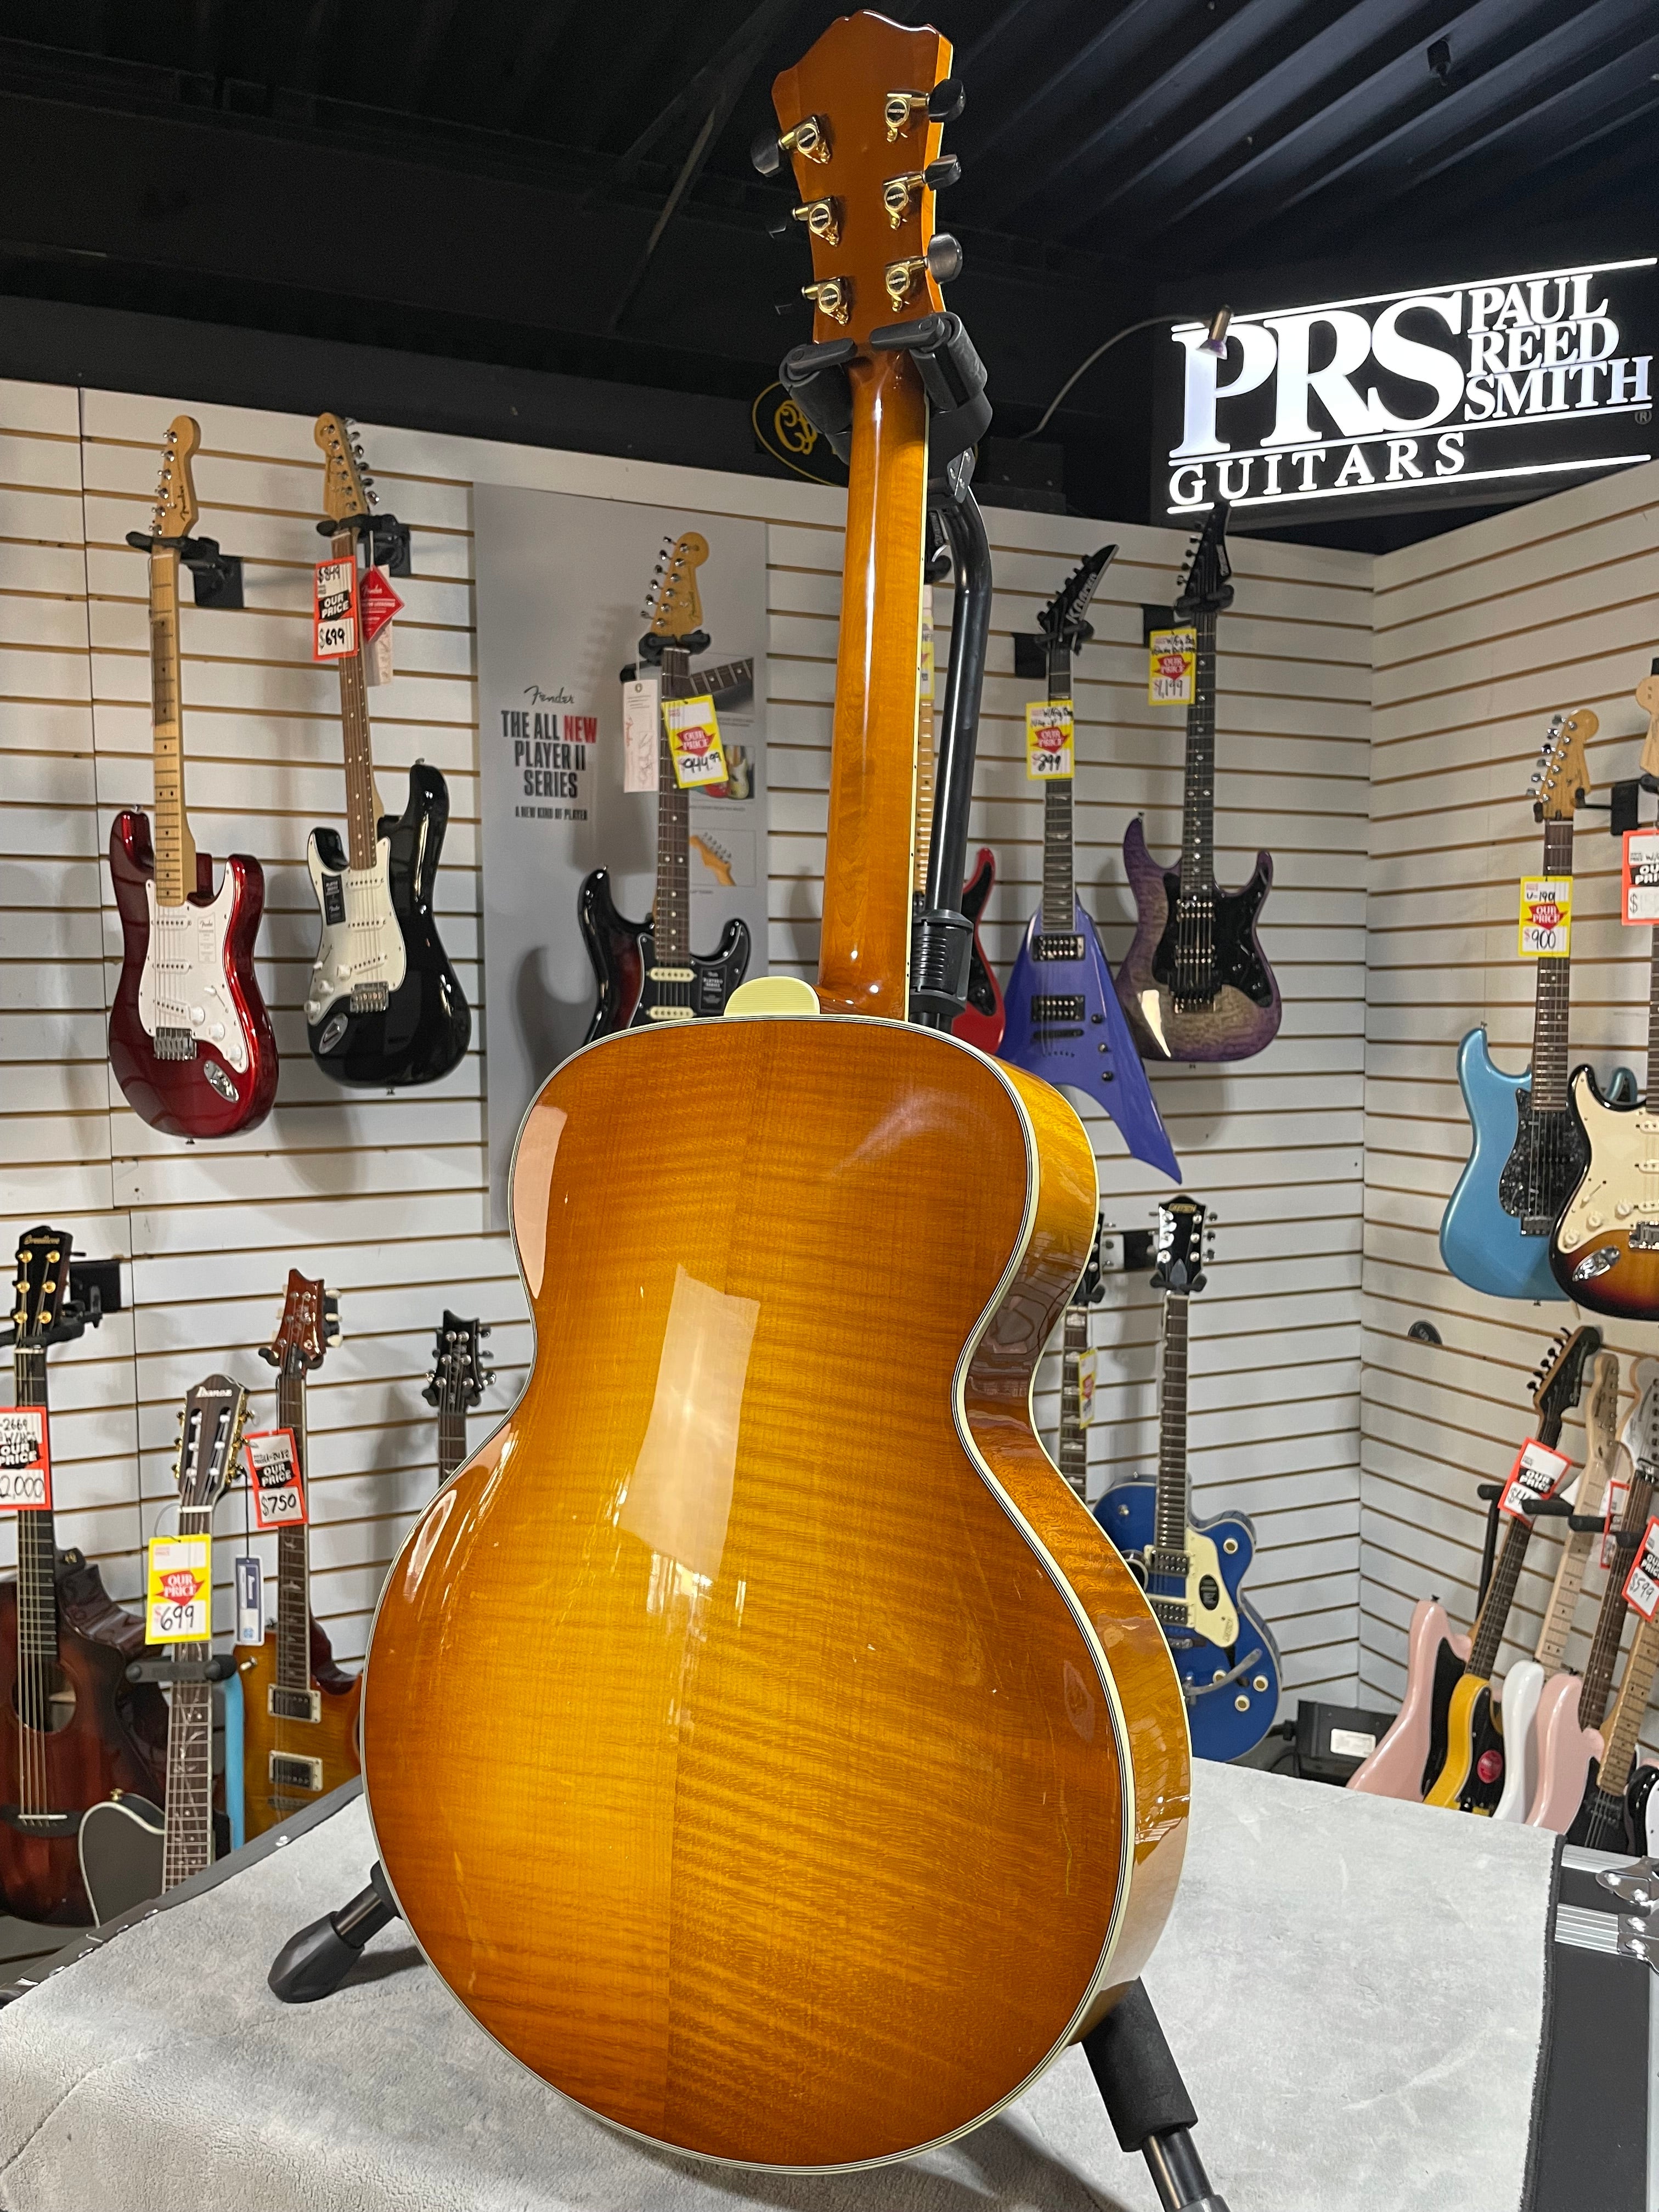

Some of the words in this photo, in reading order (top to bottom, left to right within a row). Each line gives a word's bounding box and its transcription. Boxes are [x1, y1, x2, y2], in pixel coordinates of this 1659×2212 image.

[1467, 274, 1609, 334] PAUL
[1467, 317, 1620, 377] REED
[1170, 291, 1465, 458] PRS
[1464, 356, 1653, 422] SMITH
[1168, 432, 1466, 505] GUITARS
[324, 594, 344, 608] OUR
[321, 601, 349, 619] PRICE
[1164, 658, 1182, 667] OUR
[524, 685, 575, 706] Fender
[501, 710, 530, 739] THE
[534, 713, 561, 741] ALL
[563, 715, 597, 743] NEW
[1041, 730, 1061, 739] OUR
[683, 730, 704, 741] OUR
[683, 738, 709, 751] PRICE
[515, 741, 572, 770] PLAYER
[575, 745, 586, 770] II
[524, 770, 578, 798] SERIES
[1635, 873, 1659, 885] PRI
[1532, 913, 1561, 923] PRICE
[1536, 905, 1557, 915] OUR
[1, 1442, 30, 1454] OUR
[263, 1463, 285, 1476] OUR
[1526, 1470, 1550, 1485] OUR
[261, 1470, 292, 1487] PRICE
[1519, 1474, 1551, 1493] PRICE
[261, 1493, 297, 1517] $750
[167, 1573, 193, 1586] OUR
[164, 1583, 198, 1598] PRICE
